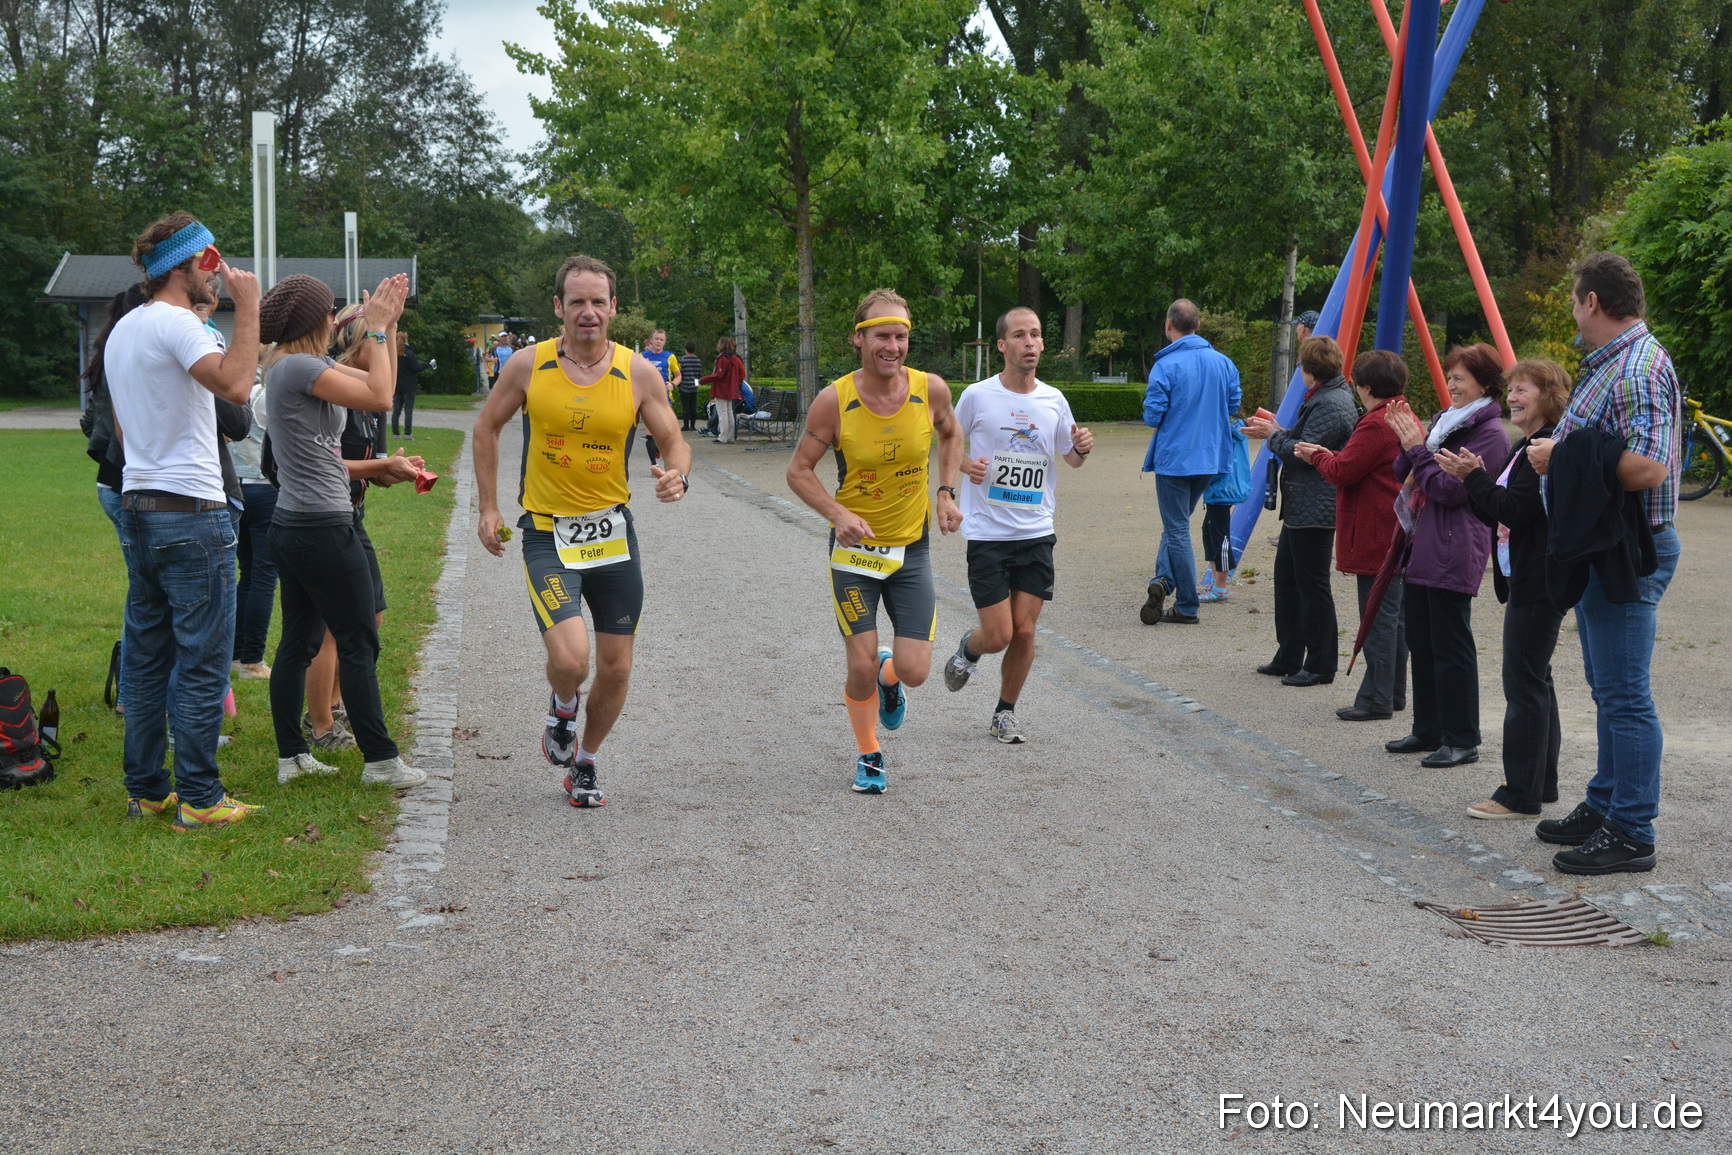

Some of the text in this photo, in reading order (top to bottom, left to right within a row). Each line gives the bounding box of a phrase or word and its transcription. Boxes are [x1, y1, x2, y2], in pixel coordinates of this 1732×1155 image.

[546, 437, 565, 446] Seidl
[586, 456, 611, 465] PIZZERIA
[994, 455, 1041, 466] PARTL Neumarkt
[996, 465, 1044, 489] 2500
[1003, 491, 1033, 502] Michael
[569, 518, 613, 544] 229
[580, 548, 604, 559] Peter
[850, 554, 883, 571] Speedy
[548, 577, 568, 600] Run!
[848, 590, 867, 614] Run!
